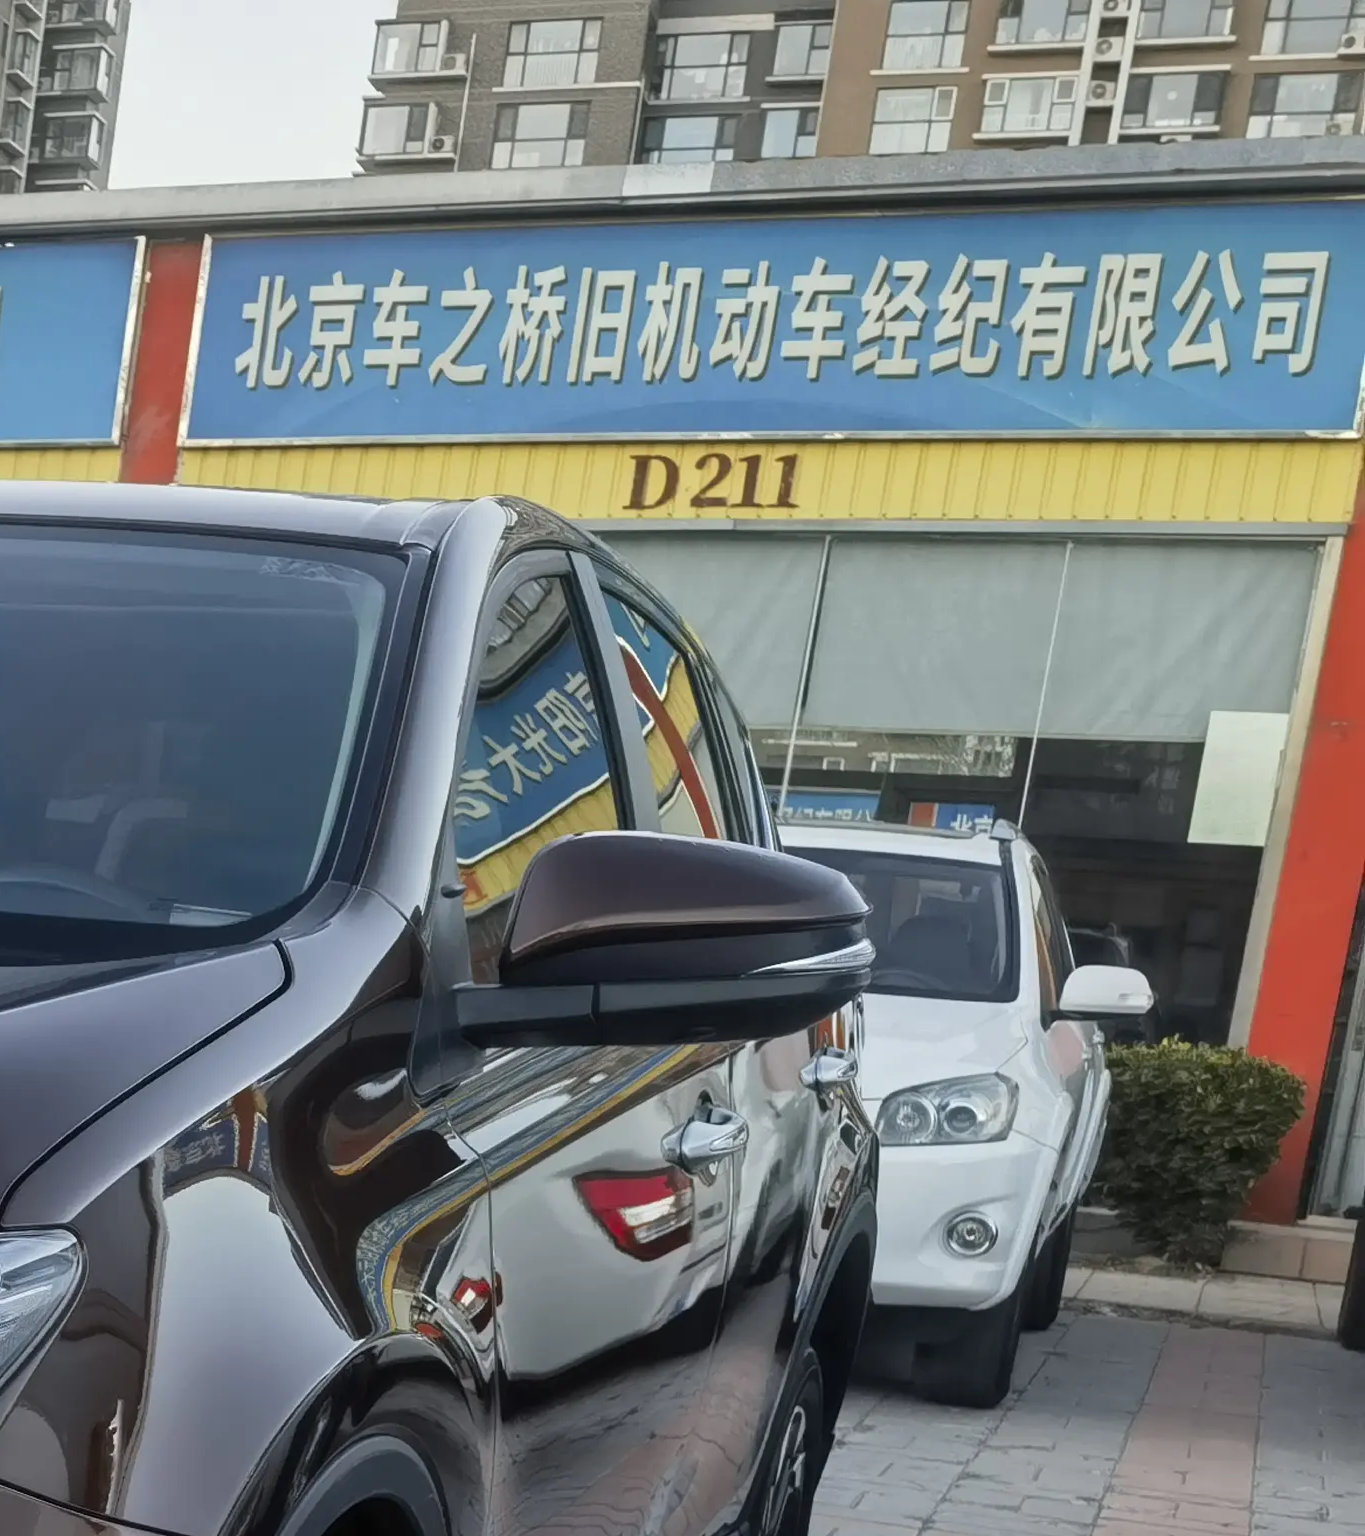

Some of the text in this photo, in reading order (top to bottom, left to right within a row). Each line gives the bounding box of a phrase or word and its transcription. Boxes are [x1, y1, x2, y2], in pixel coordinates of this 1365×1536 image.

[235, 249, 1331, 390] 北京车之桥旧机动车经纪有限公司
[622, 453, 801, 510] D211
